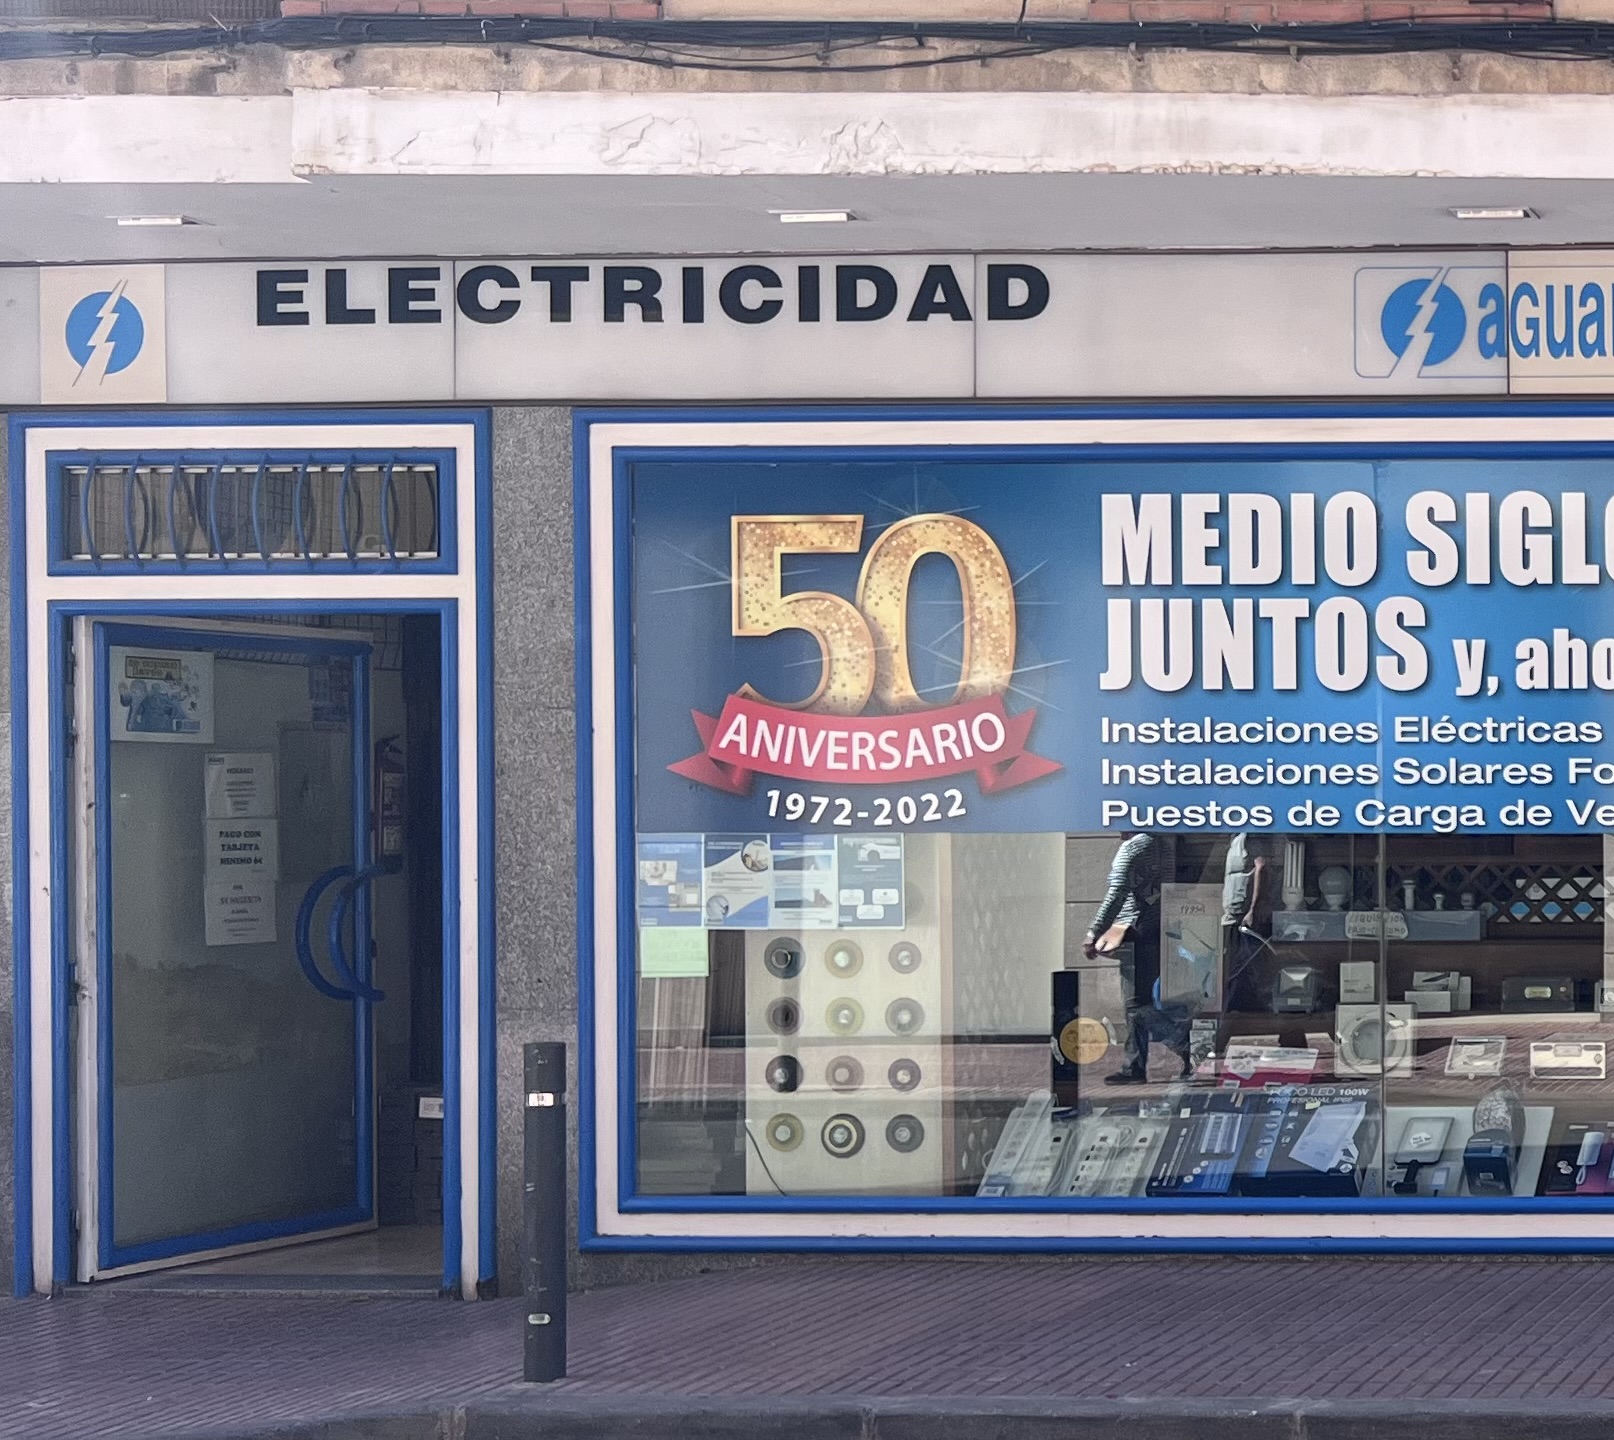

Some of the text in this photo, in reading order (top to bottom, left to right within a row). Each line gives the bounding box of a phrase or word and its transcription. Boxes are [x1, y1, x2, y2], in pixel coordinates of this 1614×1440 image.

[257, 264, 1050, 326] ELECTRICIDAD
[1101, 491, 1379, 587] MEDIO
[731, 513, 1016, 717] 50
[1099, 596, 1429, 692] JUNTOS
[1452, 638, 1499, 697] y,
[719, 712, 1007, 771] ANIVERSARIO
[1101, 715, 1604, 744] Instalaciones Eléctricas
[1101, 758, 1380, 785] Instalaciones
[1392, 757, 1554, 785] Solares
[765, 789, 967, 827] 1972-2022
[1101, 800, 1274, 827] Puestos
[1287, 799, 1341, 827] de
[1355, 799, 1486, 832] Carga
[1499, 799, 1553, 827] de
[1310, 1087, 1336, 1096] LED
